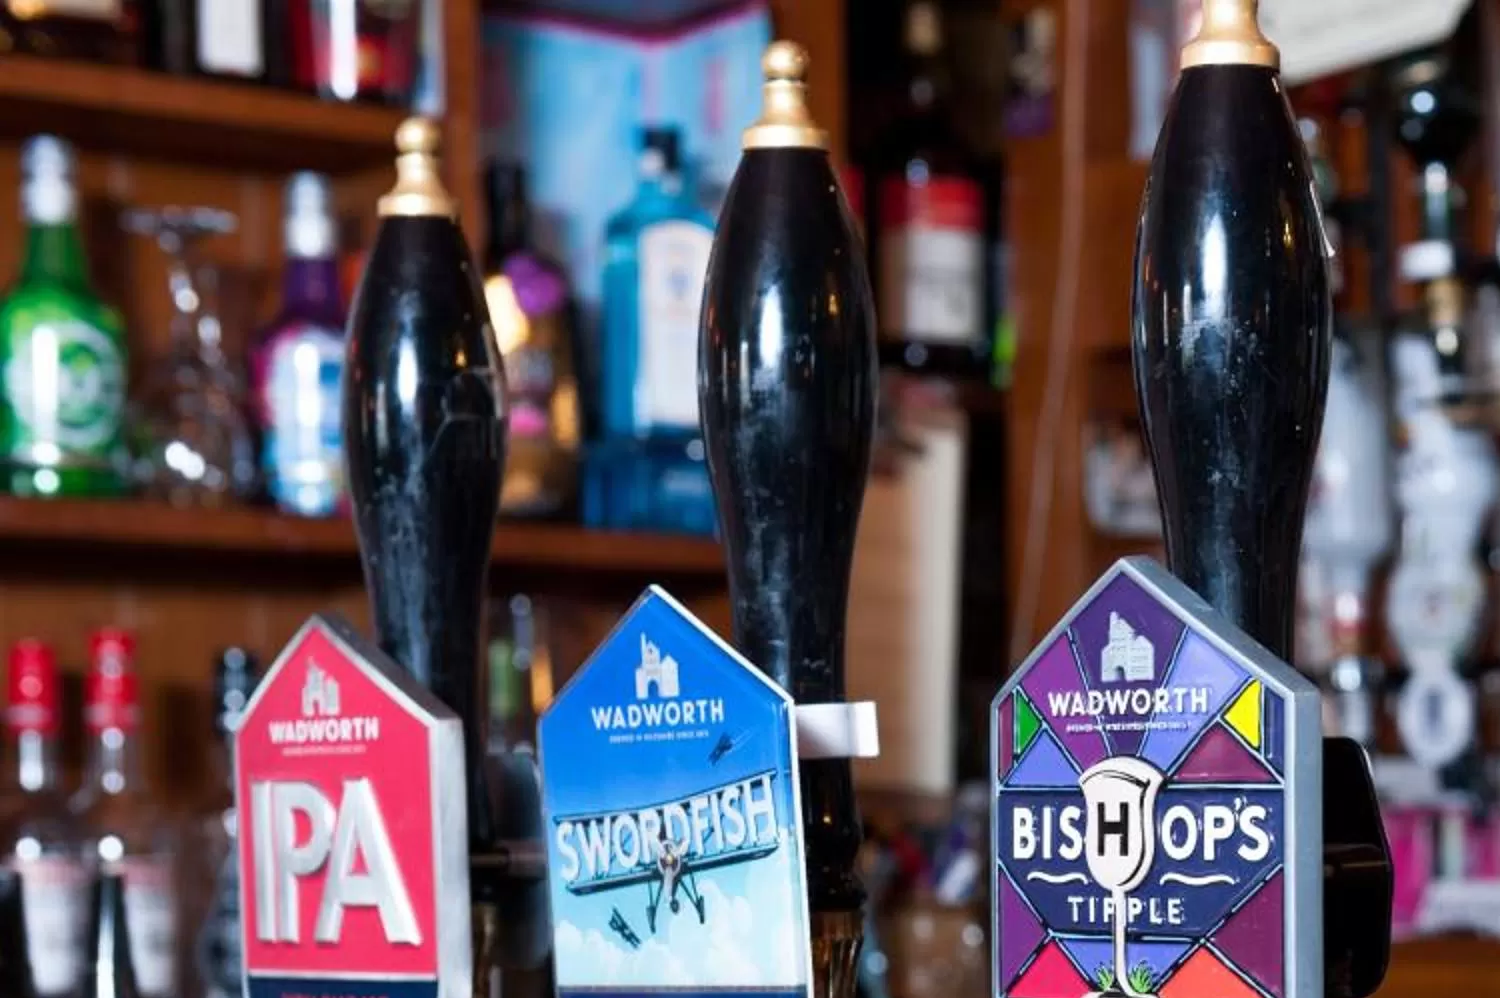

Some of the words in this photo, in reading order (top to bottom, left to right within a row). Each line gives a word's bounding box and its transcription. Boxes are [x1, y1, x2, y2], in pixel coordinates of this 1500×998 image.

[591, 697, 725, 730] WADWORTH
[1048, 687, 1209, 716] WADWORTH
[268, 716, 380, 744] WADWORTH
[556, 775, 779, 882] SWORDFISH
[1013, 797, 1273, 862] BISHOP'S
[250, 776, 423, 946] IPA
[1067, 897, 1184, 925] TIPPLE
